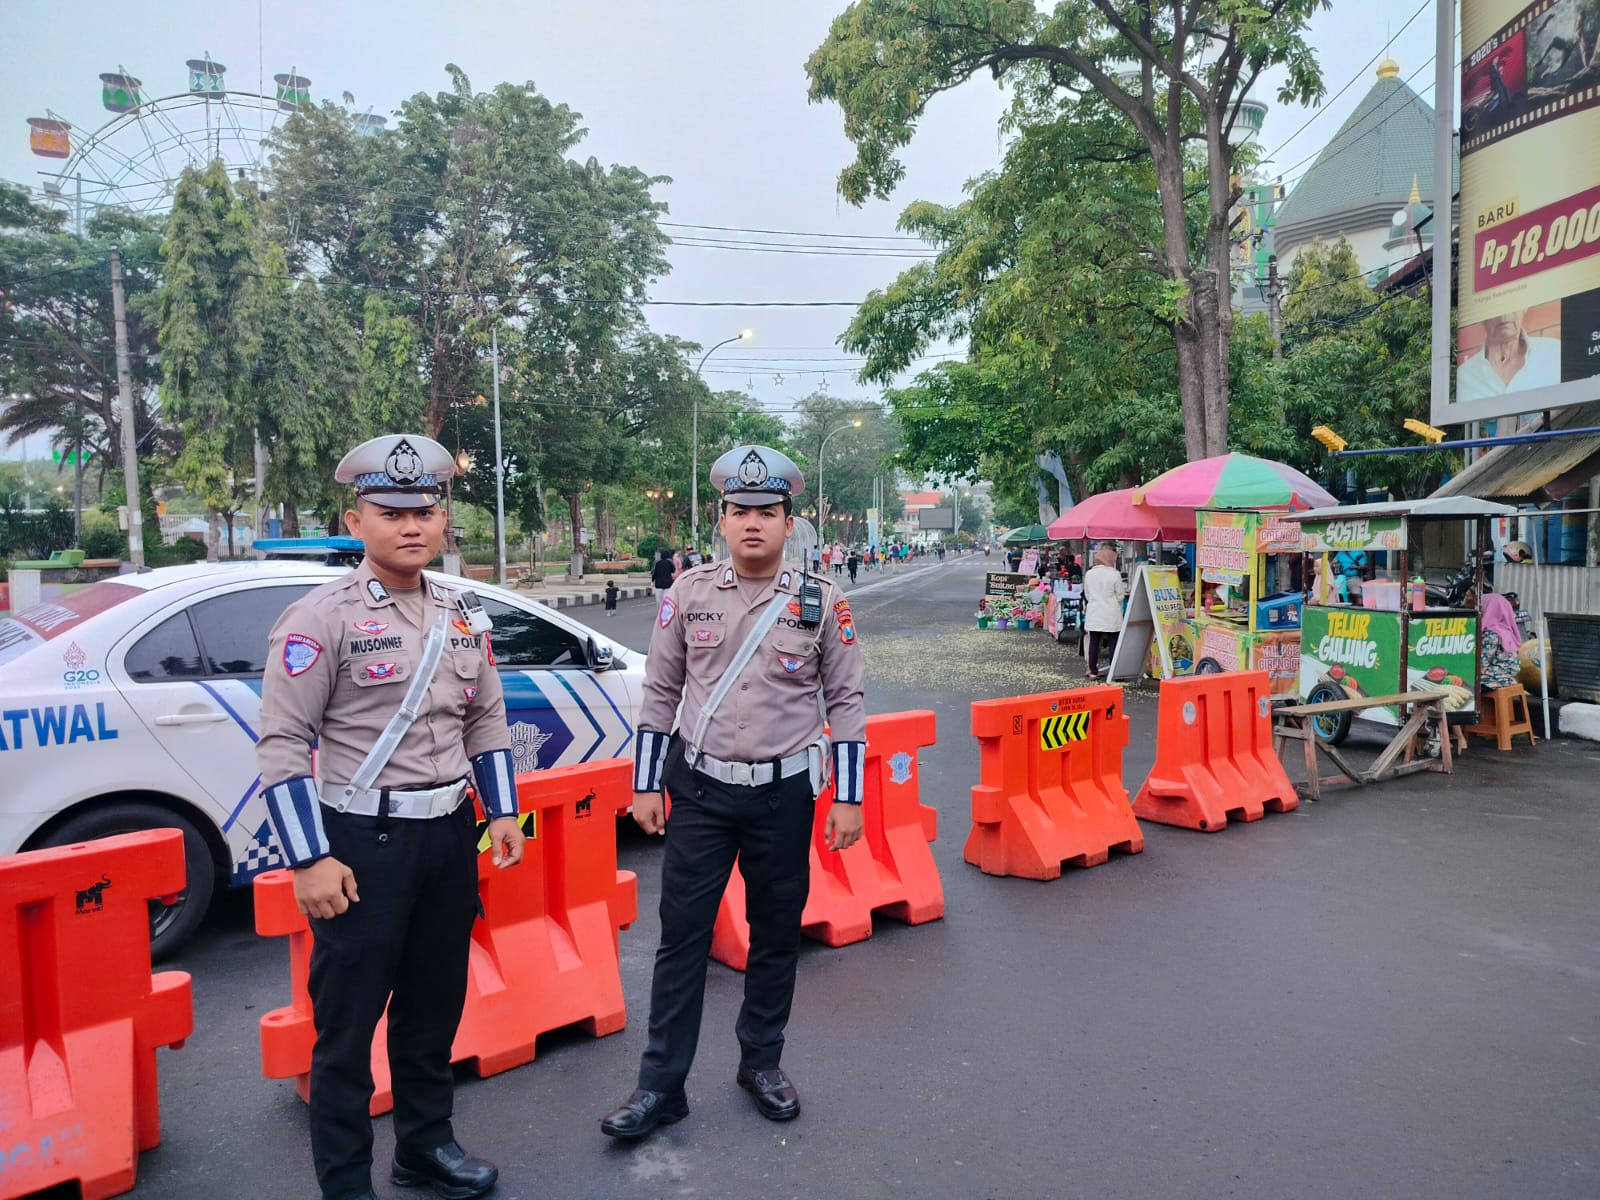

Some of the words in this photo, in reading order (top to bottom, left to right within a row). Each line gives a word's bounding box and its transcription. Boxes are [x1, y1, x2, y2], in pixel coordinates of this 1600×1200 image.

[1470, 38, 1498, 67] 2020's
[1478, 202, 1514, 228] BARU
[1326, 519, 1372, 543] SOSTEL
[1153, 588, 1182, 602] BUKA
[687, 612, 724, 622] DICKY
[1328, 611, 1371, 640] TELUR
[1425, 617, 1468, 637] TELUR
[350, 636, 403, 655] MUSONNEF
[1318, 635, 1377, 669] GULUNG
[1415, 634, 1474, 657] GULUNG
[63, 669, 100, 682] G20
